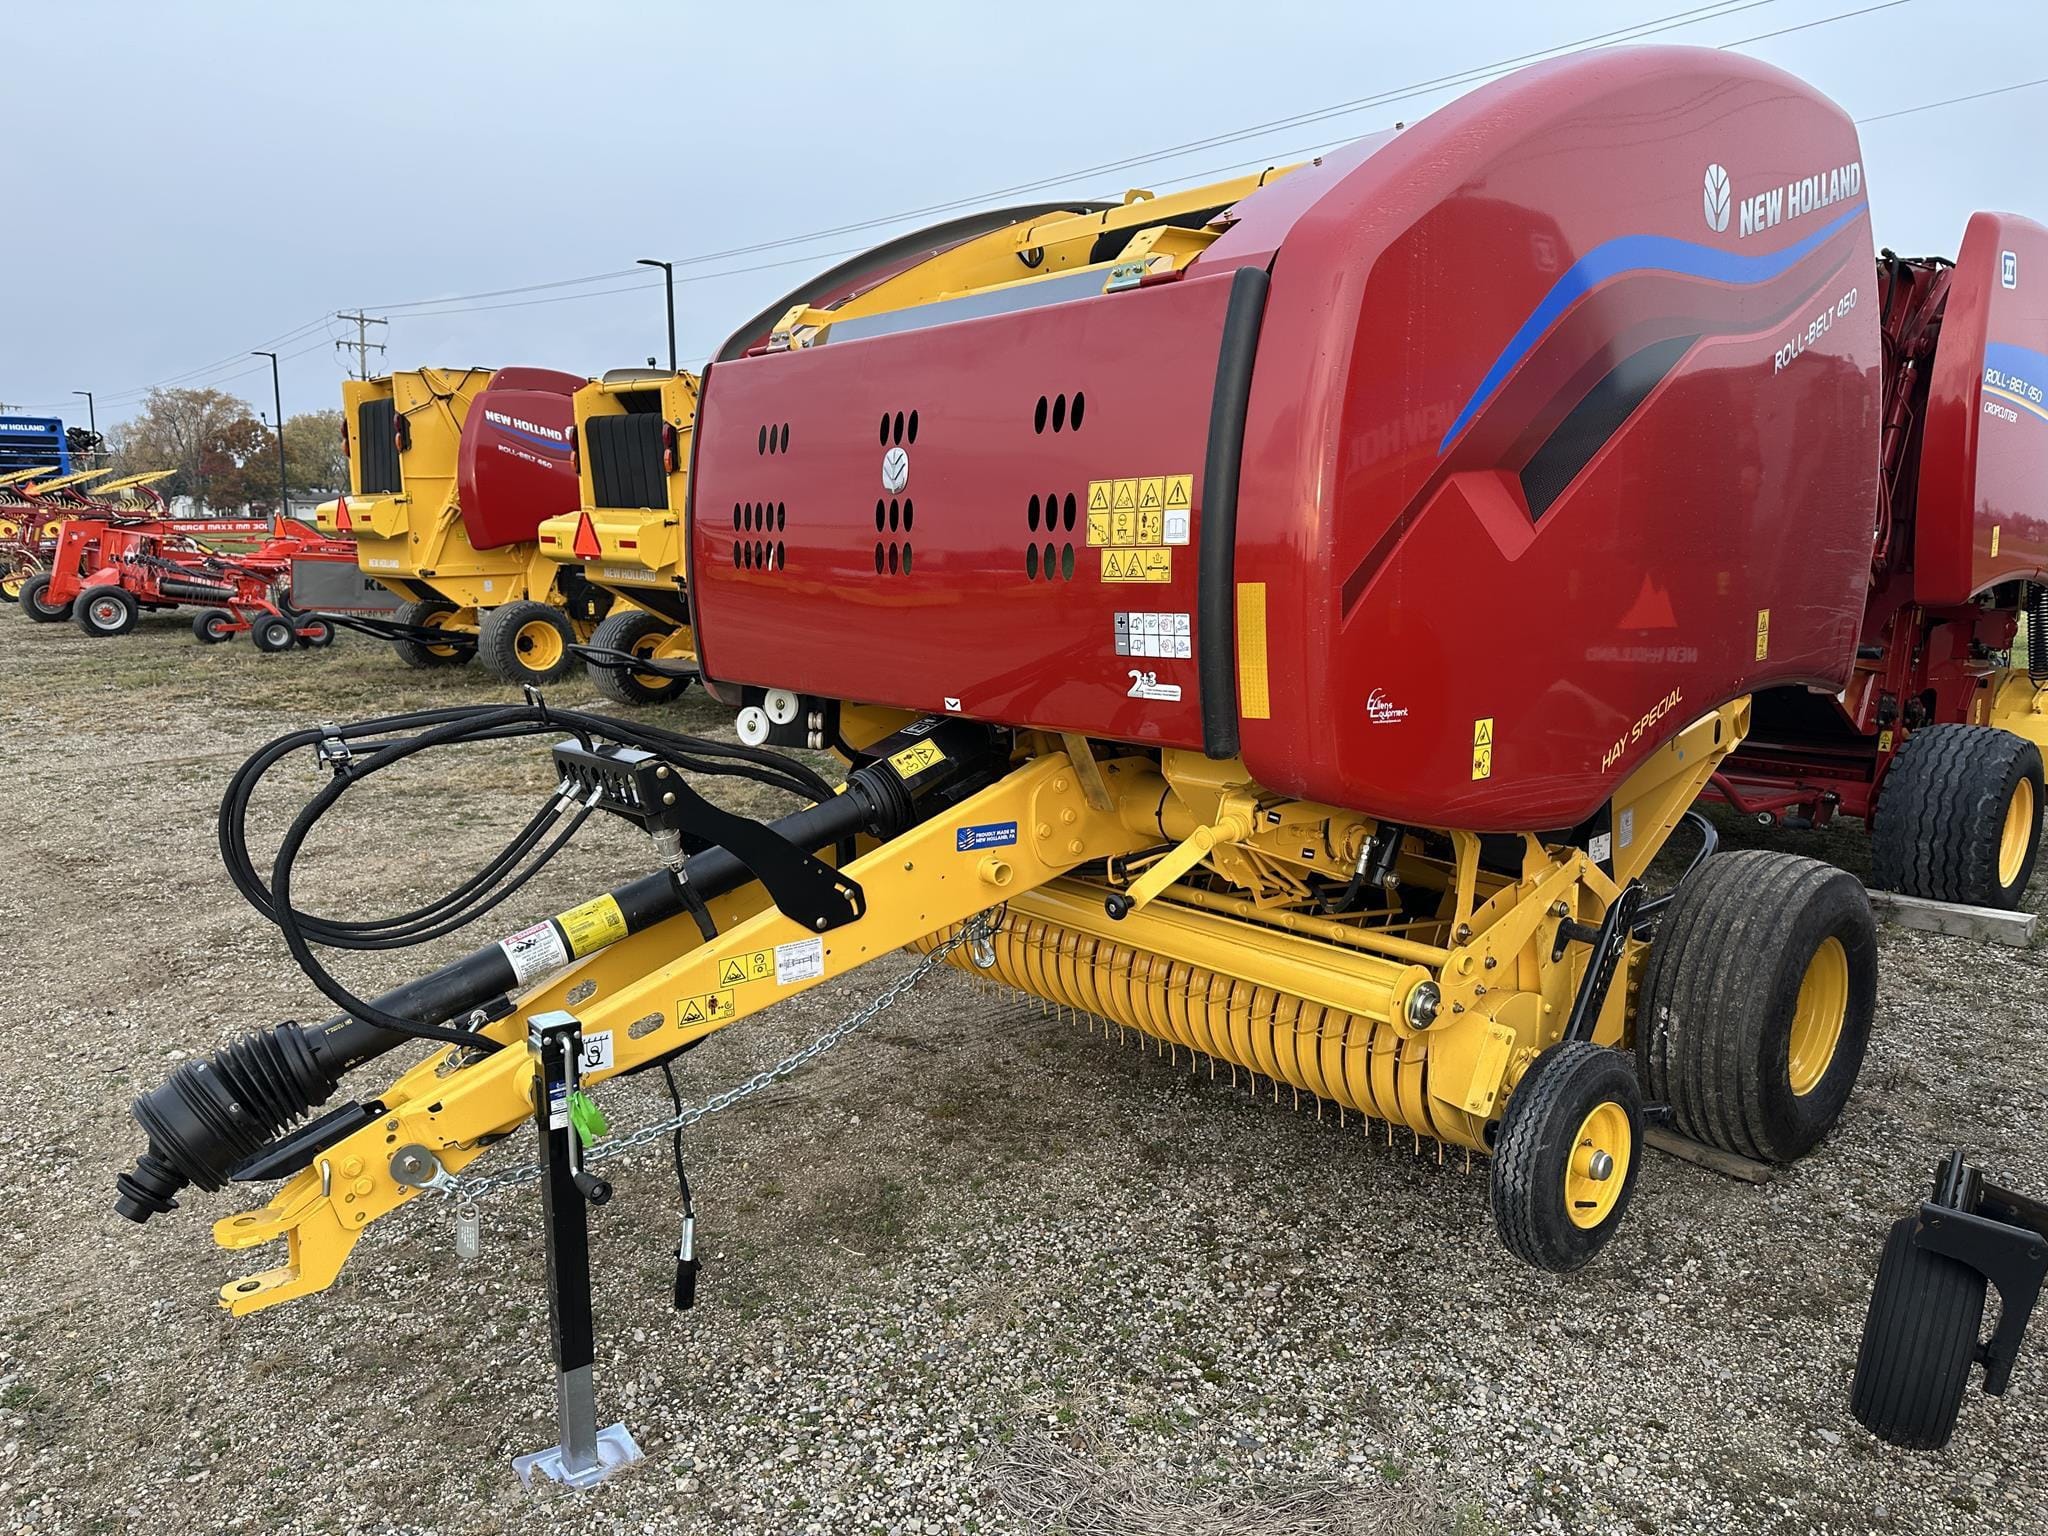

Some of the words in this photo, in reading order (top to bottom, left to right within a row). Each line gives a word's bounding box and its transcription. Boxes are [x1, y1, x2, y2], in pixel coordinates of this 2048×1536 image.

[1739, 187, 1783, 239] NEW
[1787, 162, 1861, 220] HOLLAND
[1774, 305, 1835, 375] ROLL-BELT
[1837, 287, 1857, 318] 450
[1984, 368, 2028, 395] ROLL-BELT
[2028, 385, 2043, 403] 450
[9, 424, 45, 432] HOLLAND
[485, 409, 511, 426] NEW
[513, 418, 562, 441] HOLLAND
[1983, 401, 2018, 423] CROPCUTTER
[364, 579, 388, 591] KU
[603, 567, 620, 579] NEW
[621, 569, 656, 583] HOLLAND
[1601, 731, 1629, 774] HAY
[1630, 686, 1683, 744] SPECIAL
